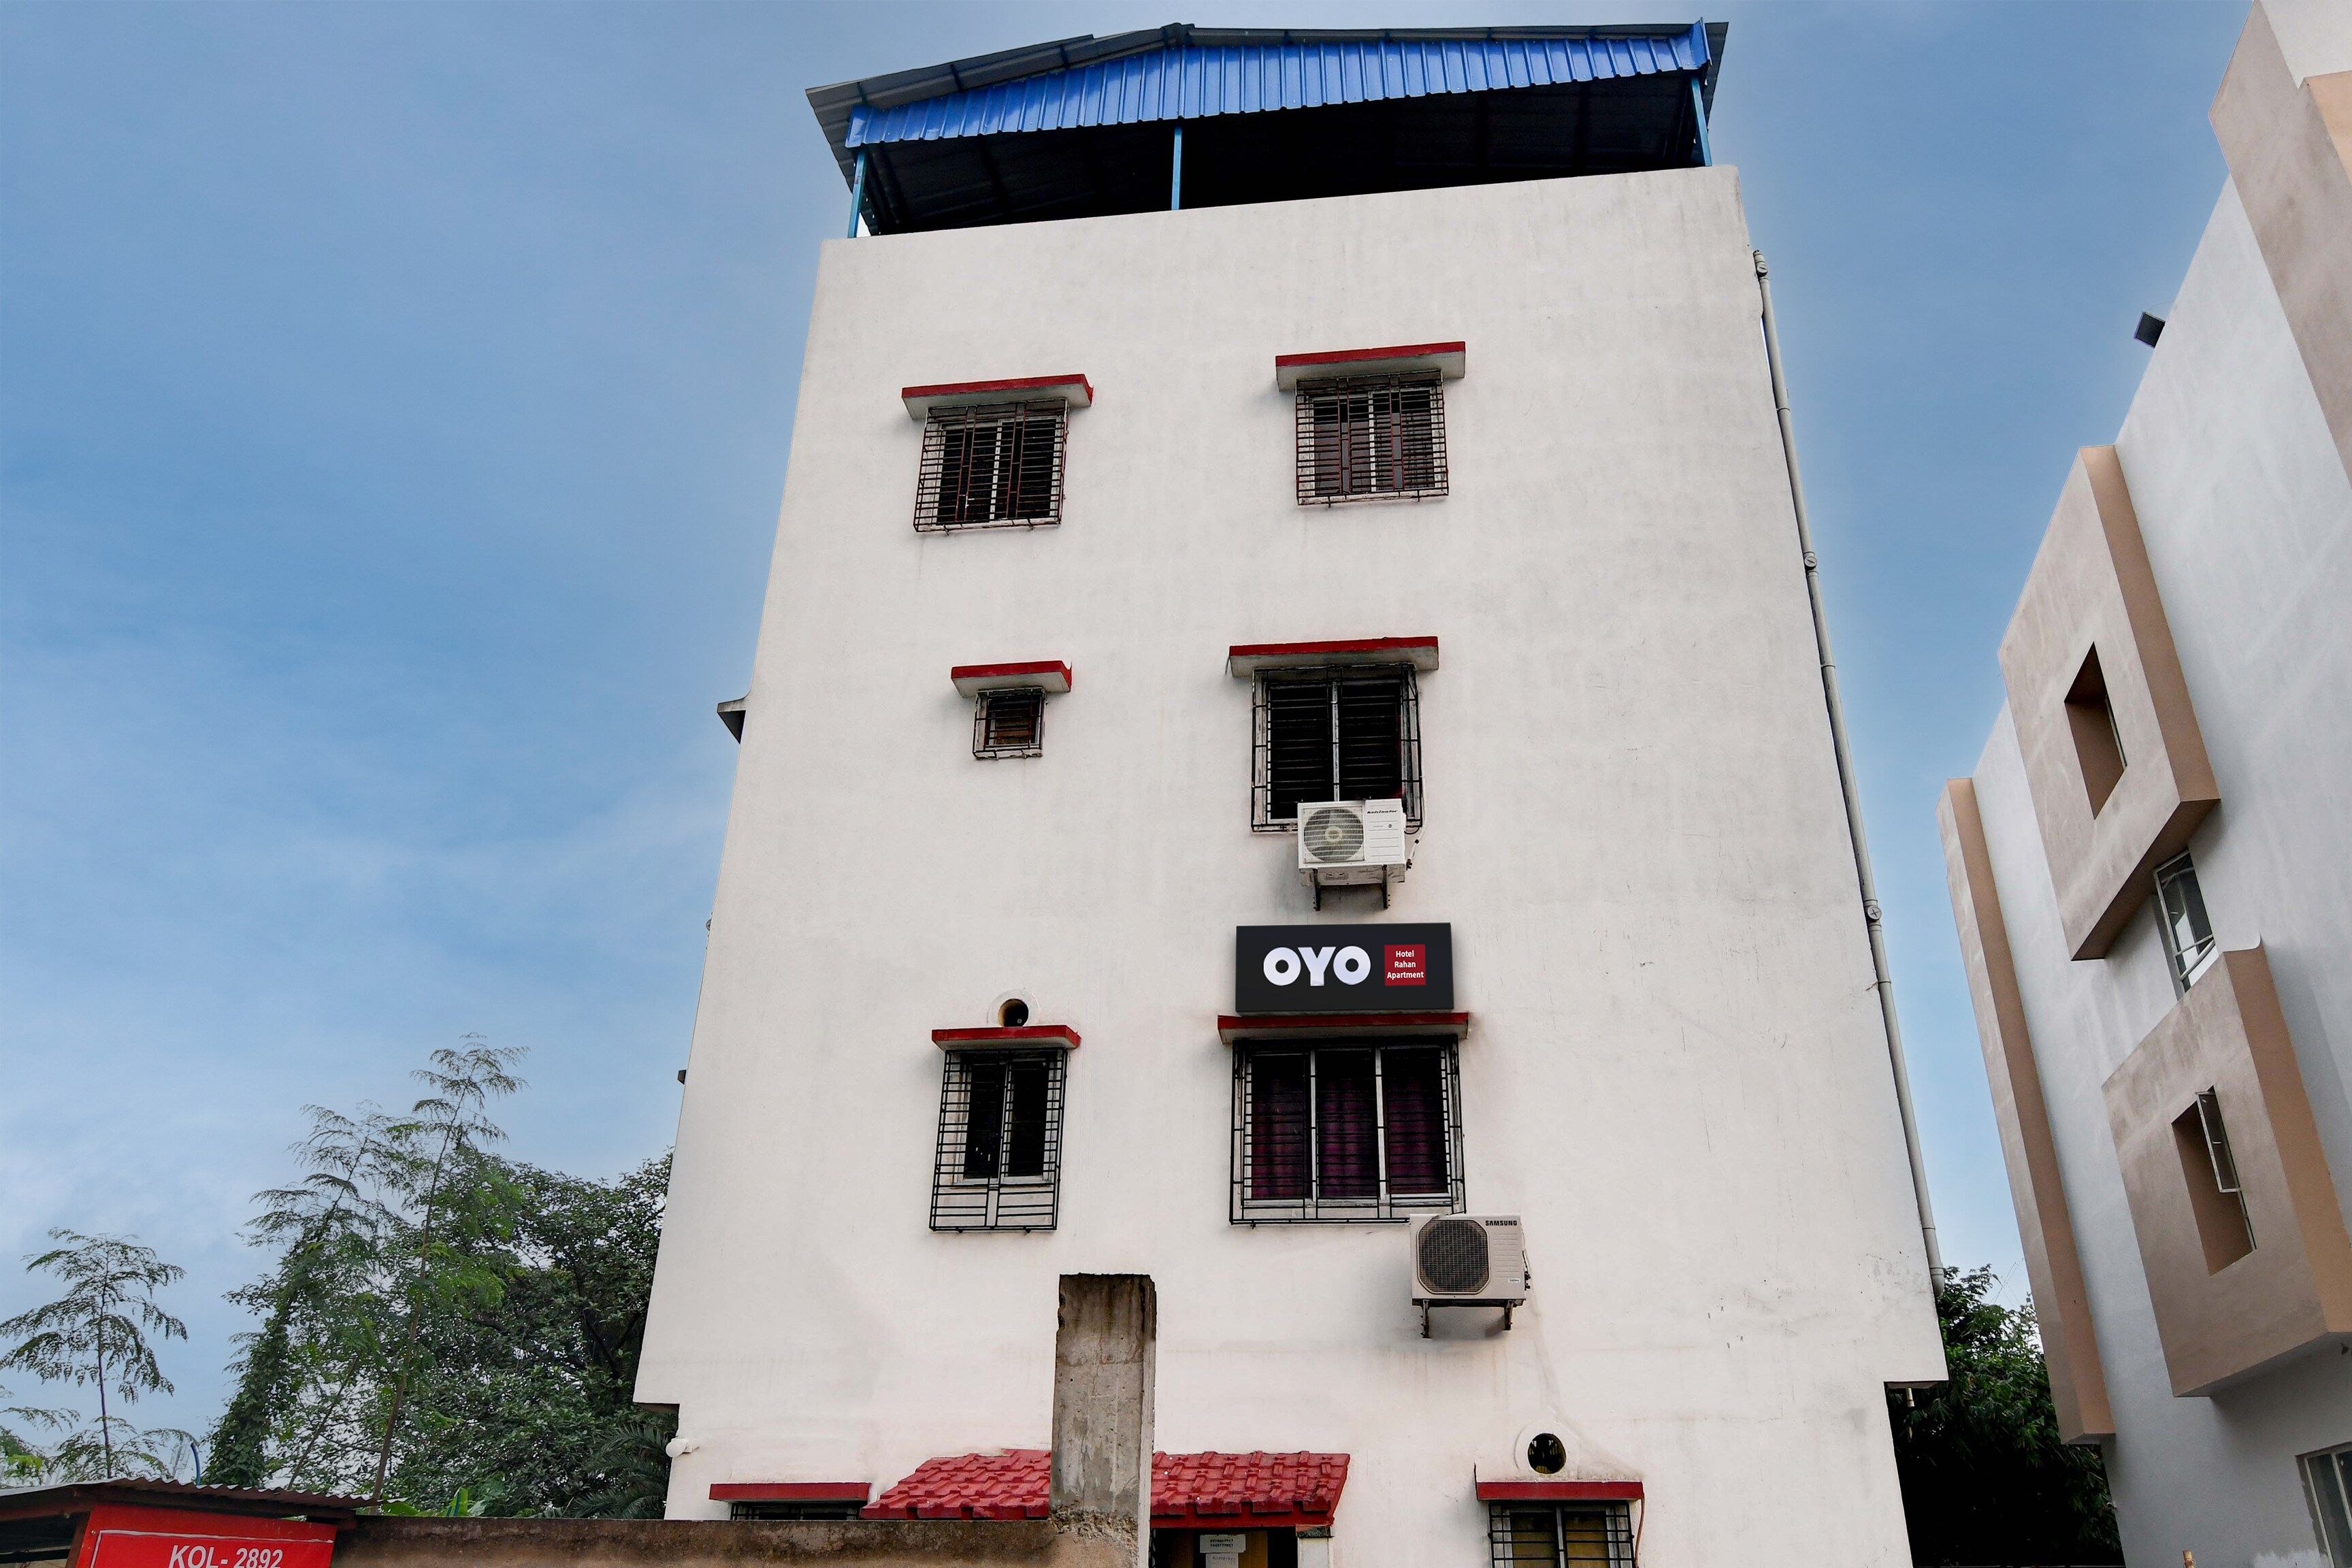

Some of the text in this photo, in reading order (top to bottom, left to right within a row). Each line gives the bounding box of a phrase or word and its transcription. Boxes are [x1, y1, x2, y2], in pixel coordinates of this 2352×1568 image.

[1395, 949, 1415, 958] Hotel
[1263, 945, 1371, 987] OYO
[1394, 960, 1416, 968] Rahan
[1386, 971, 1424, 981] Apartment
[168, 1545, 284, 1568] KOL- 2892
